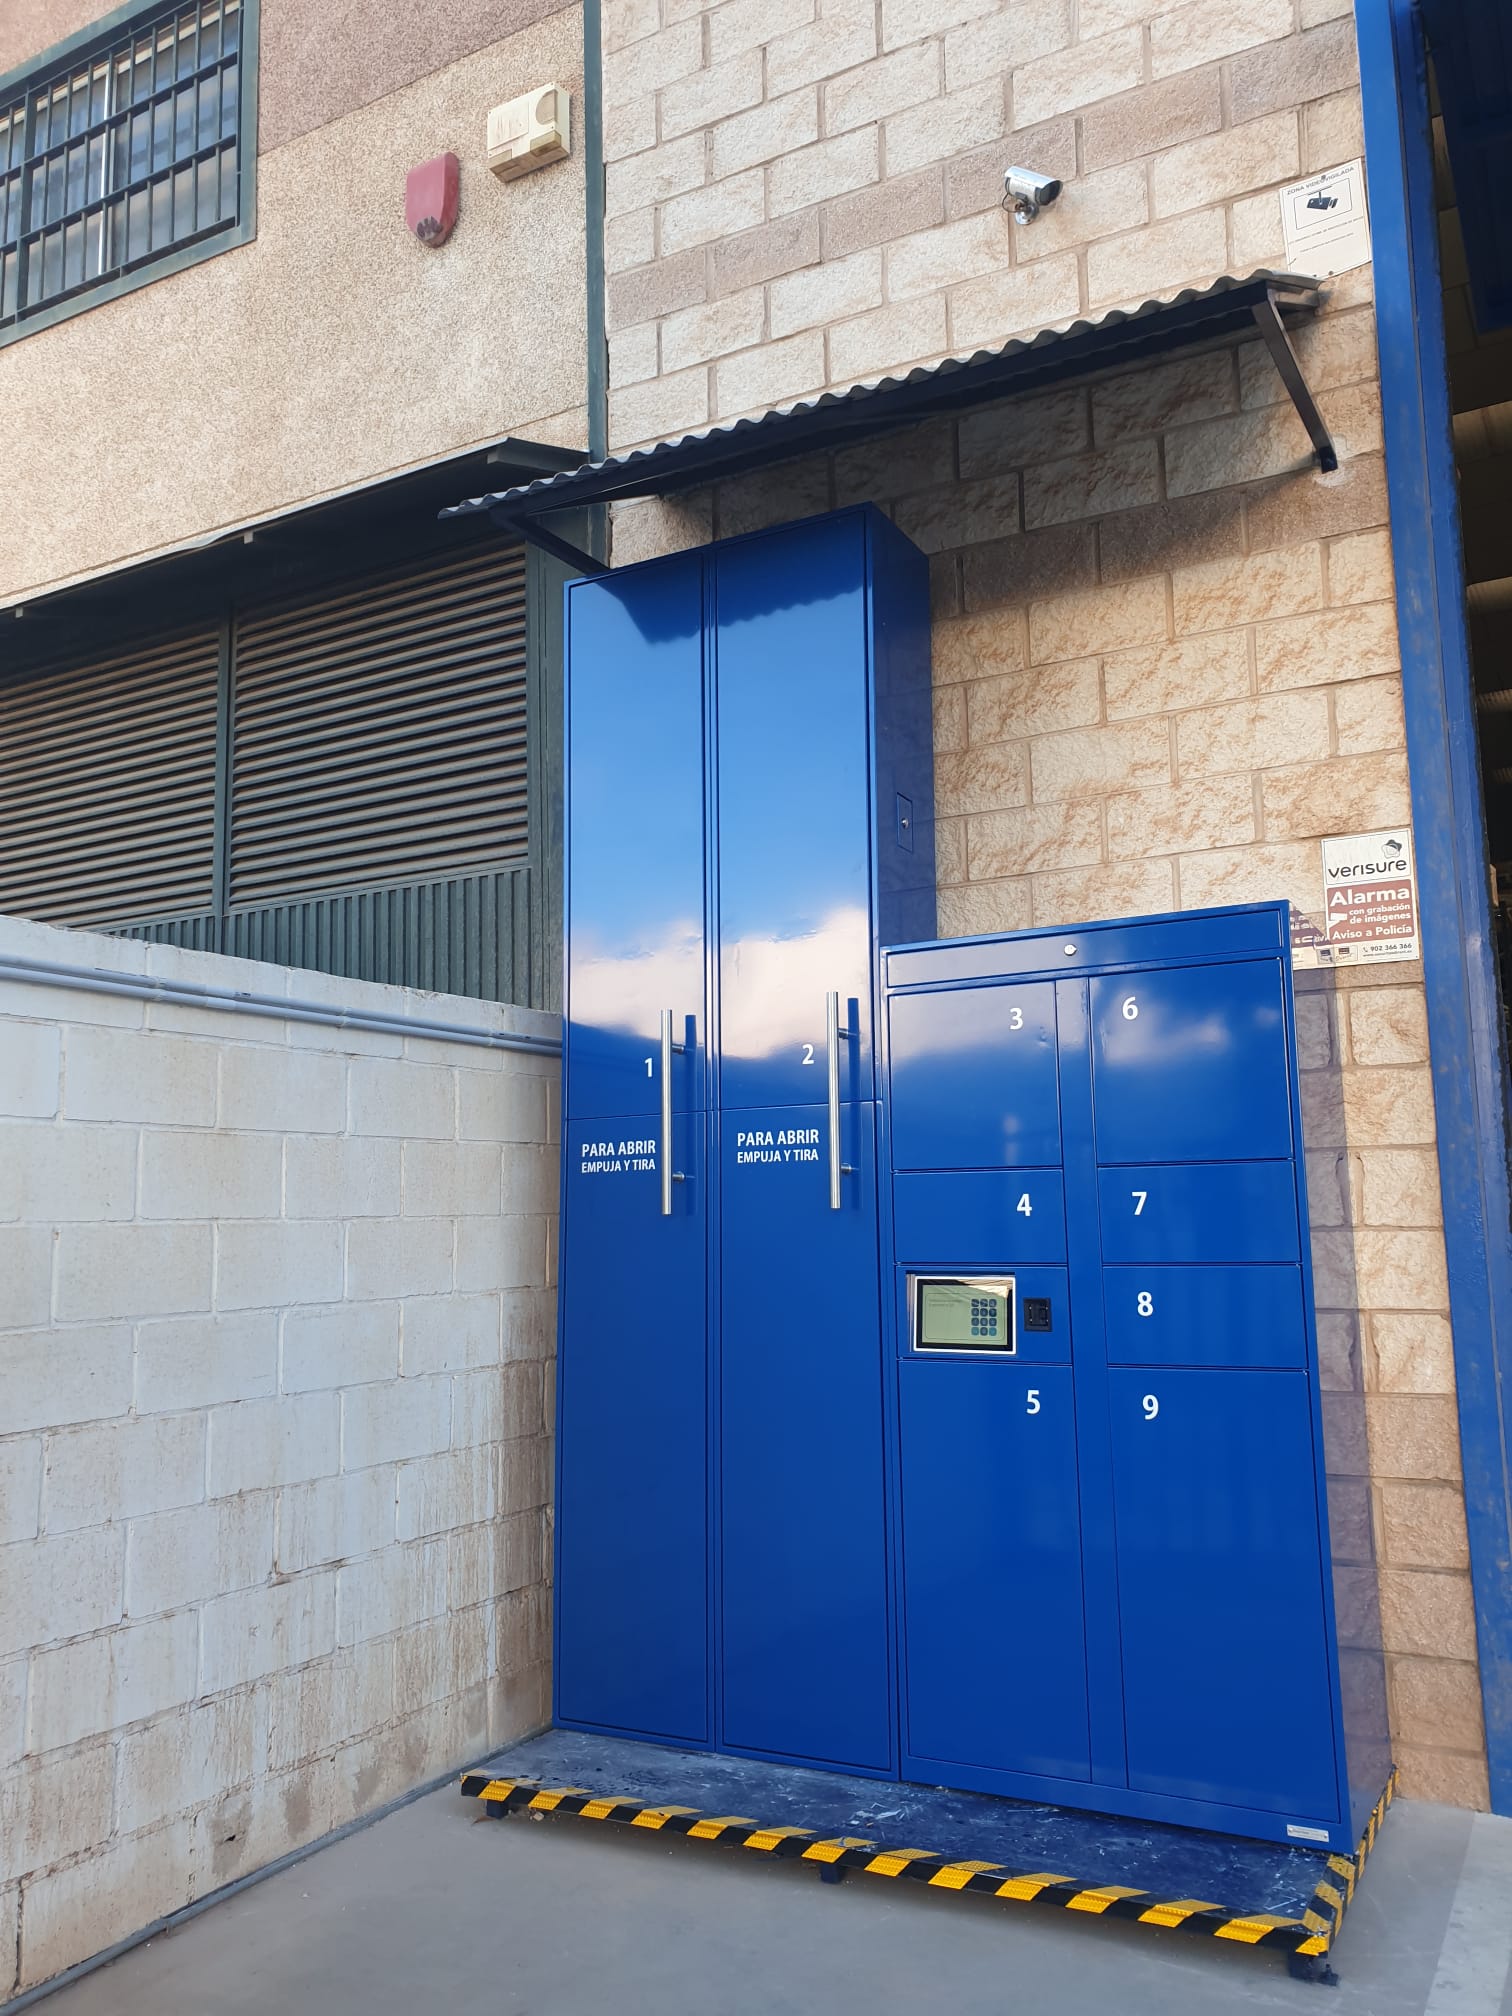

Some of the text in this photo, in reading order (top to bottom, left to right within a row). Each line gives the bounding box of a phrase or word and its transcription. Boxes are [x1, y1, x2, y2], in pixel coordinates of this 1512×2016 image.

[1287, 185, 1305, 195] ZONA
[1328, 860, 1407, 878] verisure
[1330, 888, 1410, 907] Alarma
[1349, 903, 1410, 916] con grabación
[1350, 912, 1411, 924] de imágenes
[1333, 930, 1362, 940] Aviso
[1376, 924, 1412, 936] Policía
[1122, 996, 1138, 1020] 6
[1009, 1007, 1023, 1030] 3
[802, 1044, 815, 1065] 2
[644, 1057, 653, 1078] 1
[737, 1129, 819, 1147] PARA ABRIR
[582, 1140, 656, 1157] PARA ABRIR
[737, 1148, 819, 1164] EMPUJA Y TIRA
[581, 1158, 656, 1174] EMPUJA Y TIRA
[1016, 1193, 1033, 1217] 4
[1131, 1191, 1148, 1216] 7
[1137, 1291, 1154, 1317] 8
[1026, 1389, 1041, 1414] 5
[1142, 1394, 1159, 1420] 9
